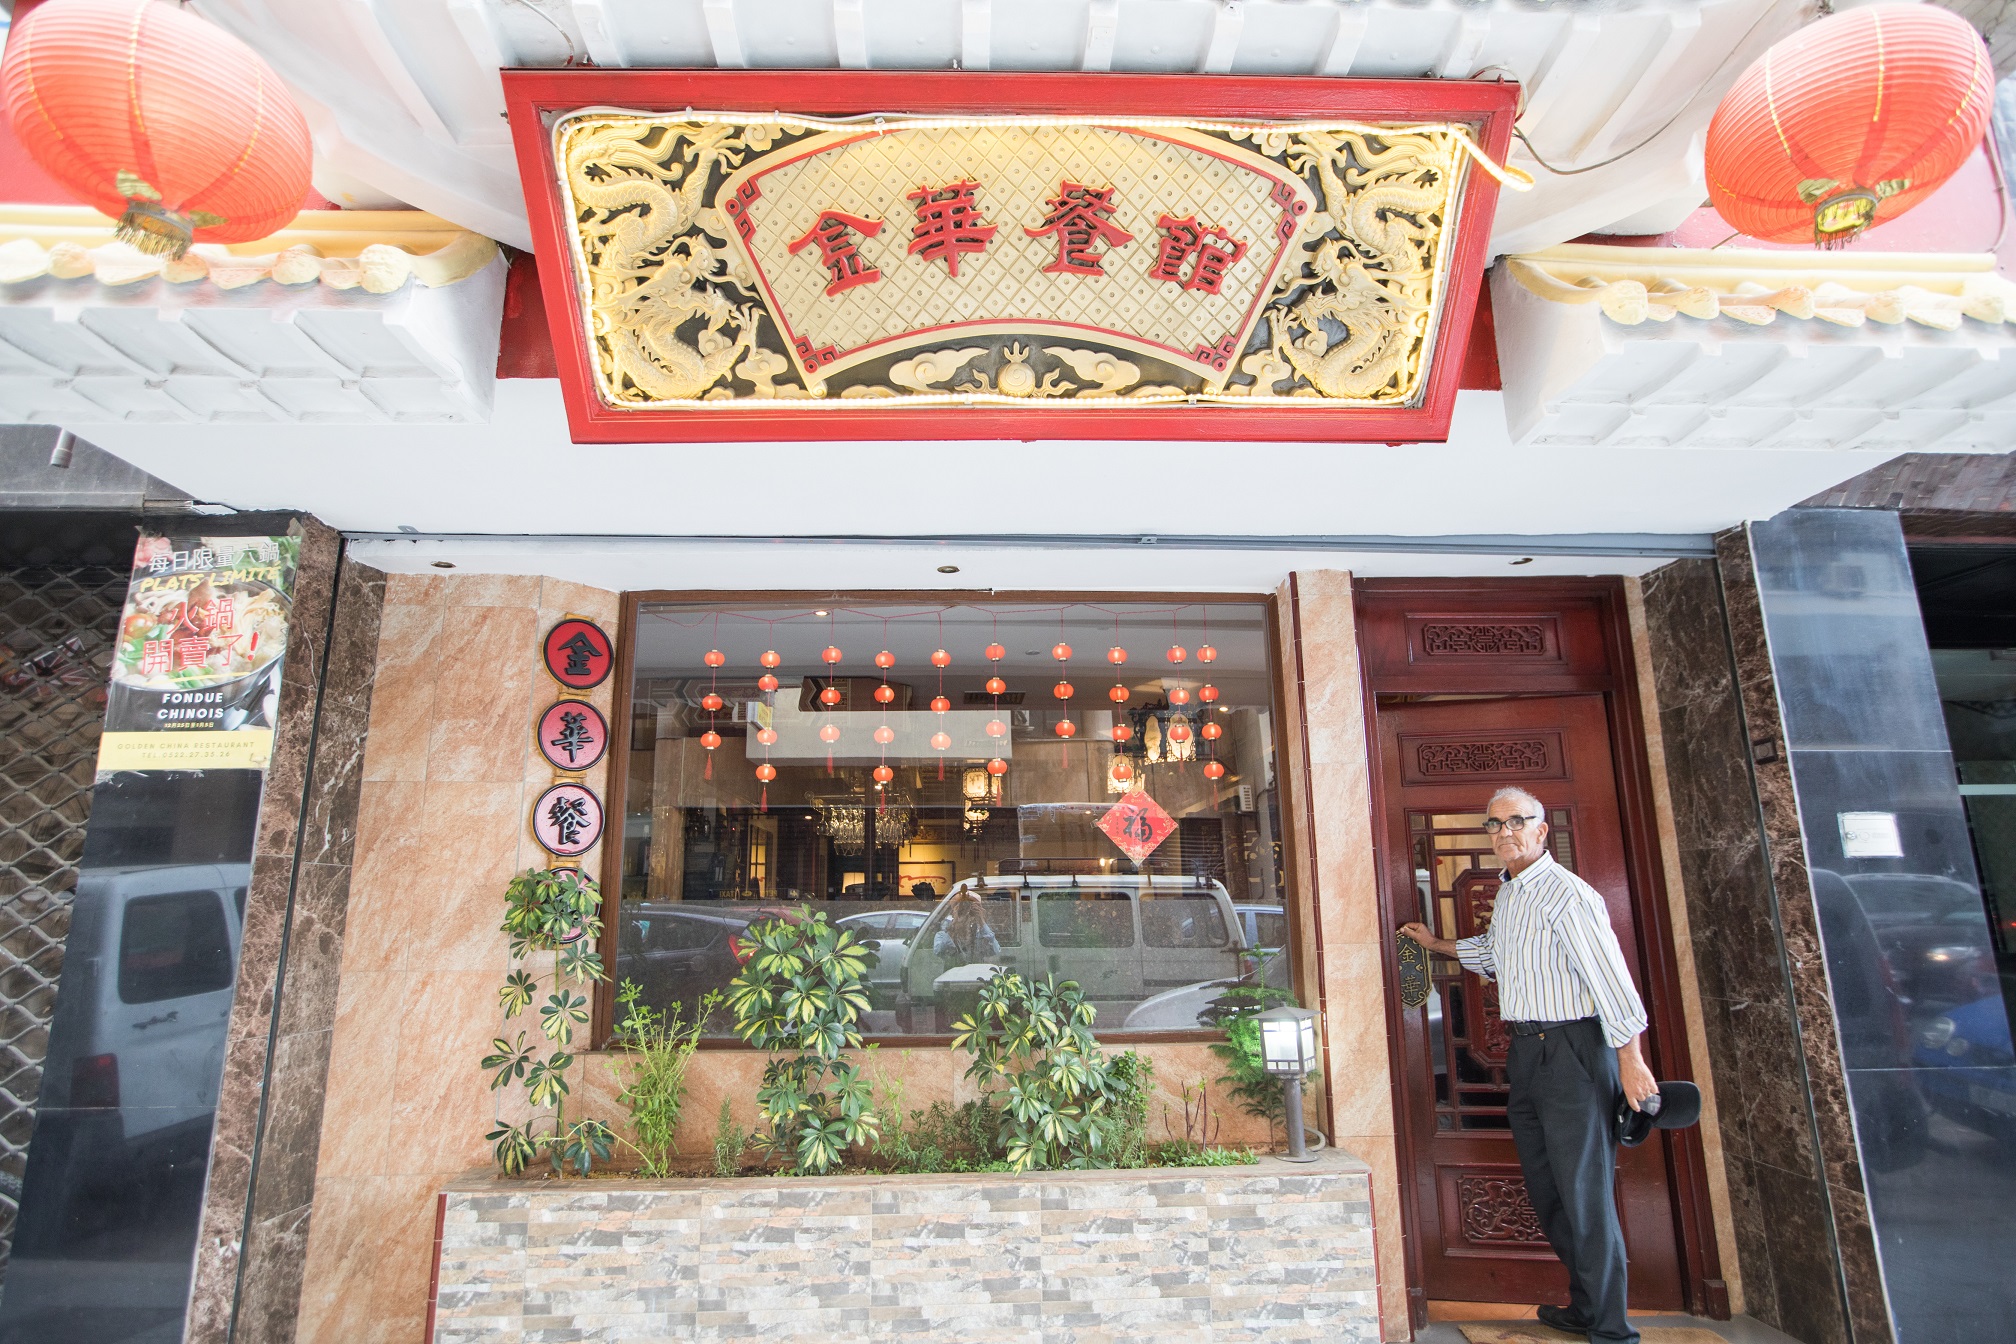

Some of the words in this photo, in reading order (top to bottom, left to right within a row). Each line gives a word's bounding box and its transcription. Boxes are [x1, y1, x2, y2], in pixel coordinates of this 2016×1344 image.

[787, 178, 1248, 298] 金華餐館
[149, 542, 280, 573] 每日限量六鍋
[140, 573, 204, 593] PLATS
[208, 560, 282, 586] LIMITÉ
[166, 597, 235, 636] 火鍋
[157, 708, 225, 719] CHINOIS
[162, 692, 224, 704] FONDUE
[193, 741, 255, 749] RESTAURANT
[1123, 807, 1153, 842] 福
[1398, 943, 1420, 996] 金華
